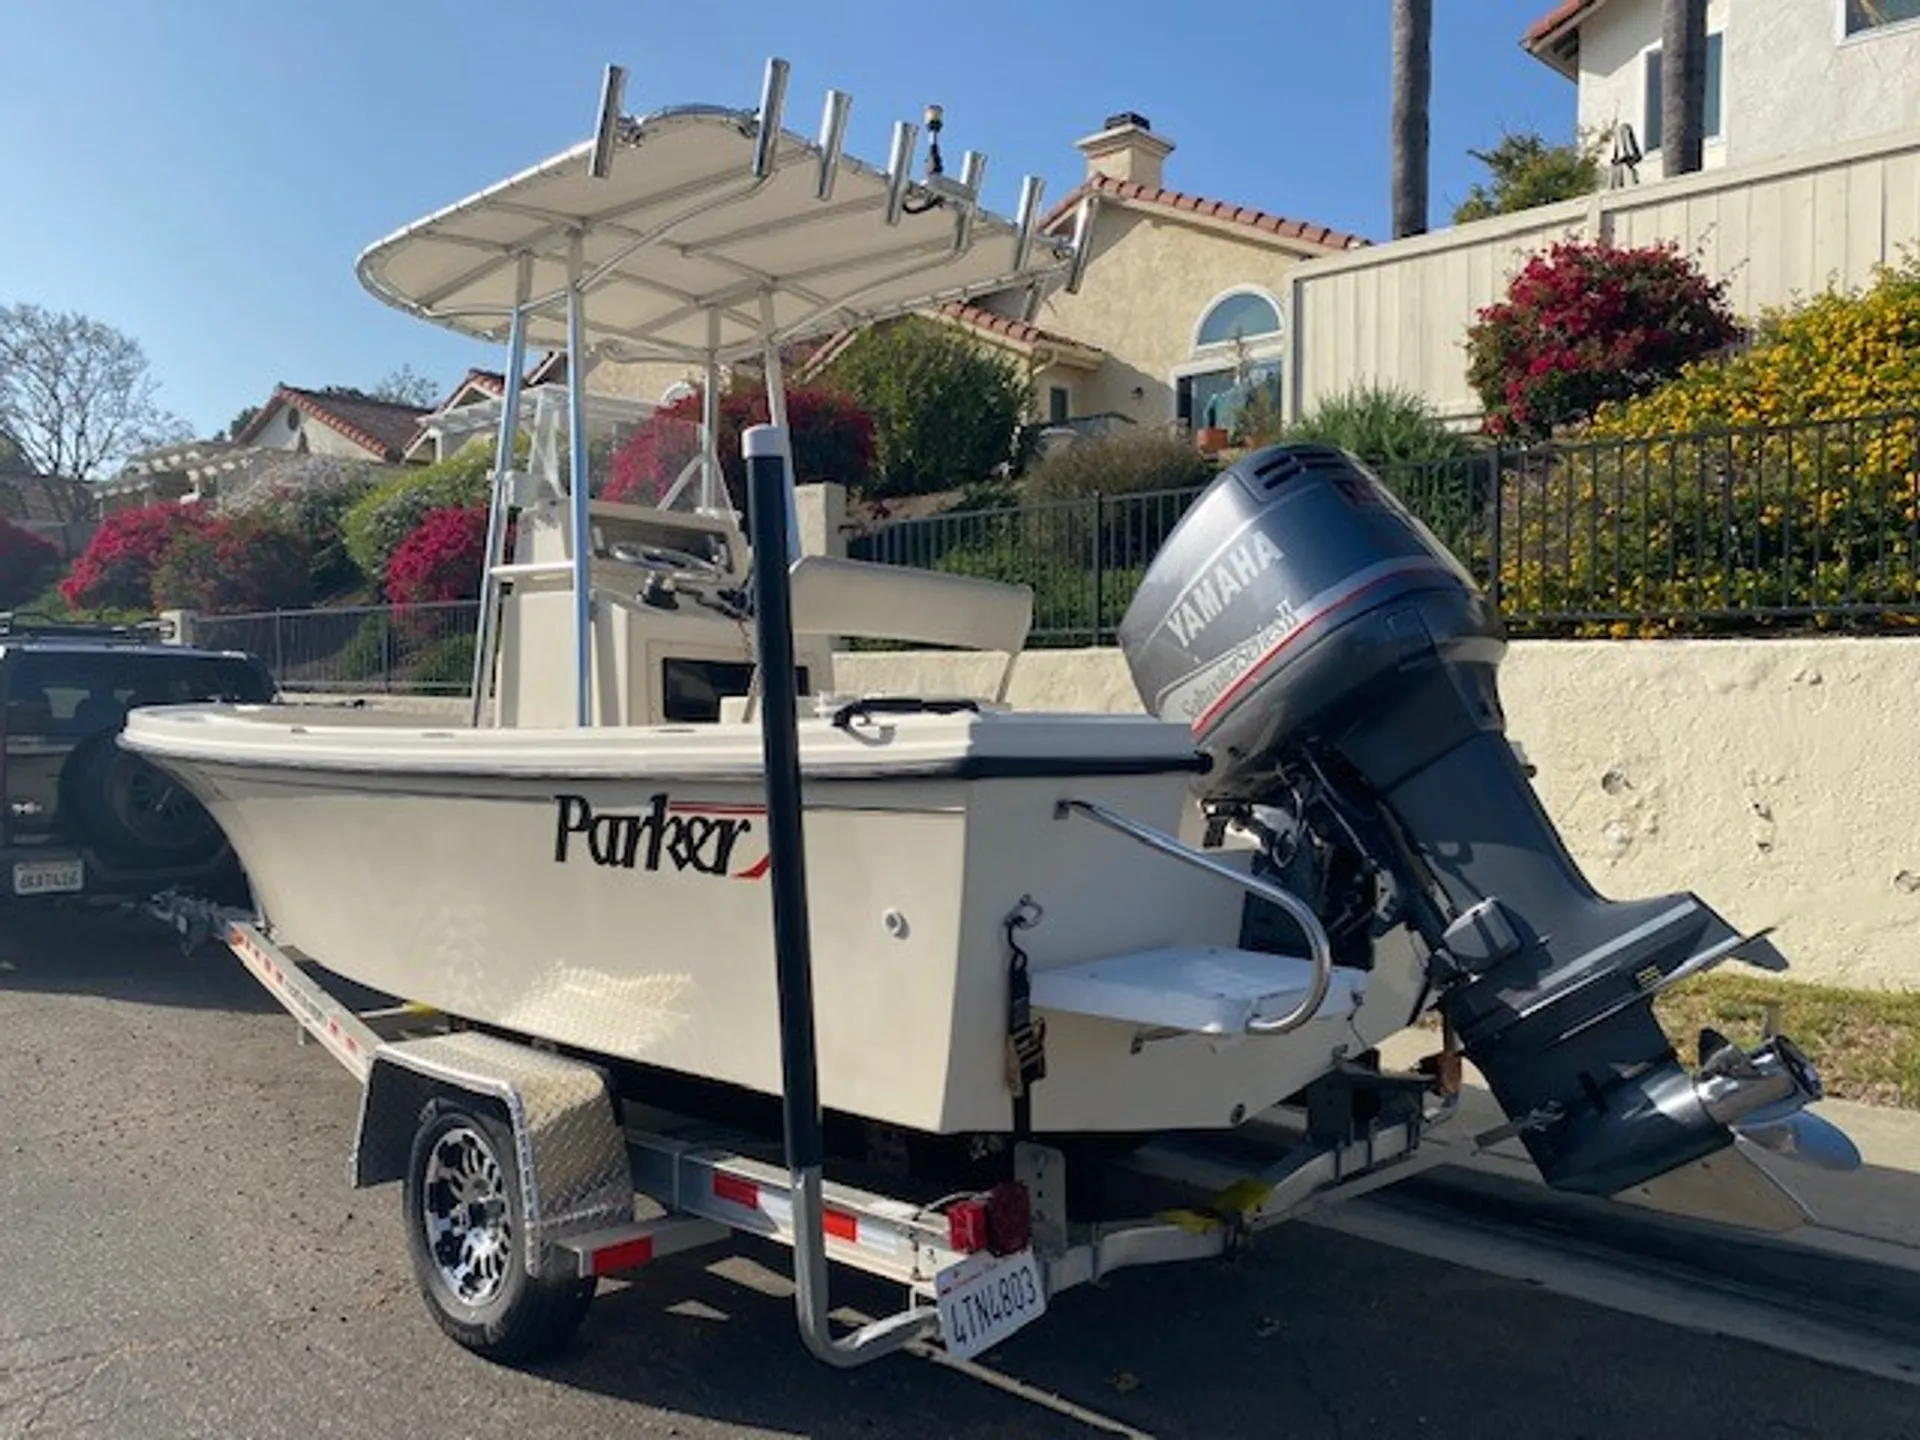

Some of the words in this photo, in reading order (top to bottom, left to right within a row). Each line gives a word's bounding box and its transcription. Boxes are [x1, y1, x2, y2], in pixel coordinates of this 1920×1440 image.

[1166, 529, 1285, 649] YAMAHA
[553, 792, 752, 877] Parker
[950, 1265, 1037, 1345] 4TN4803
